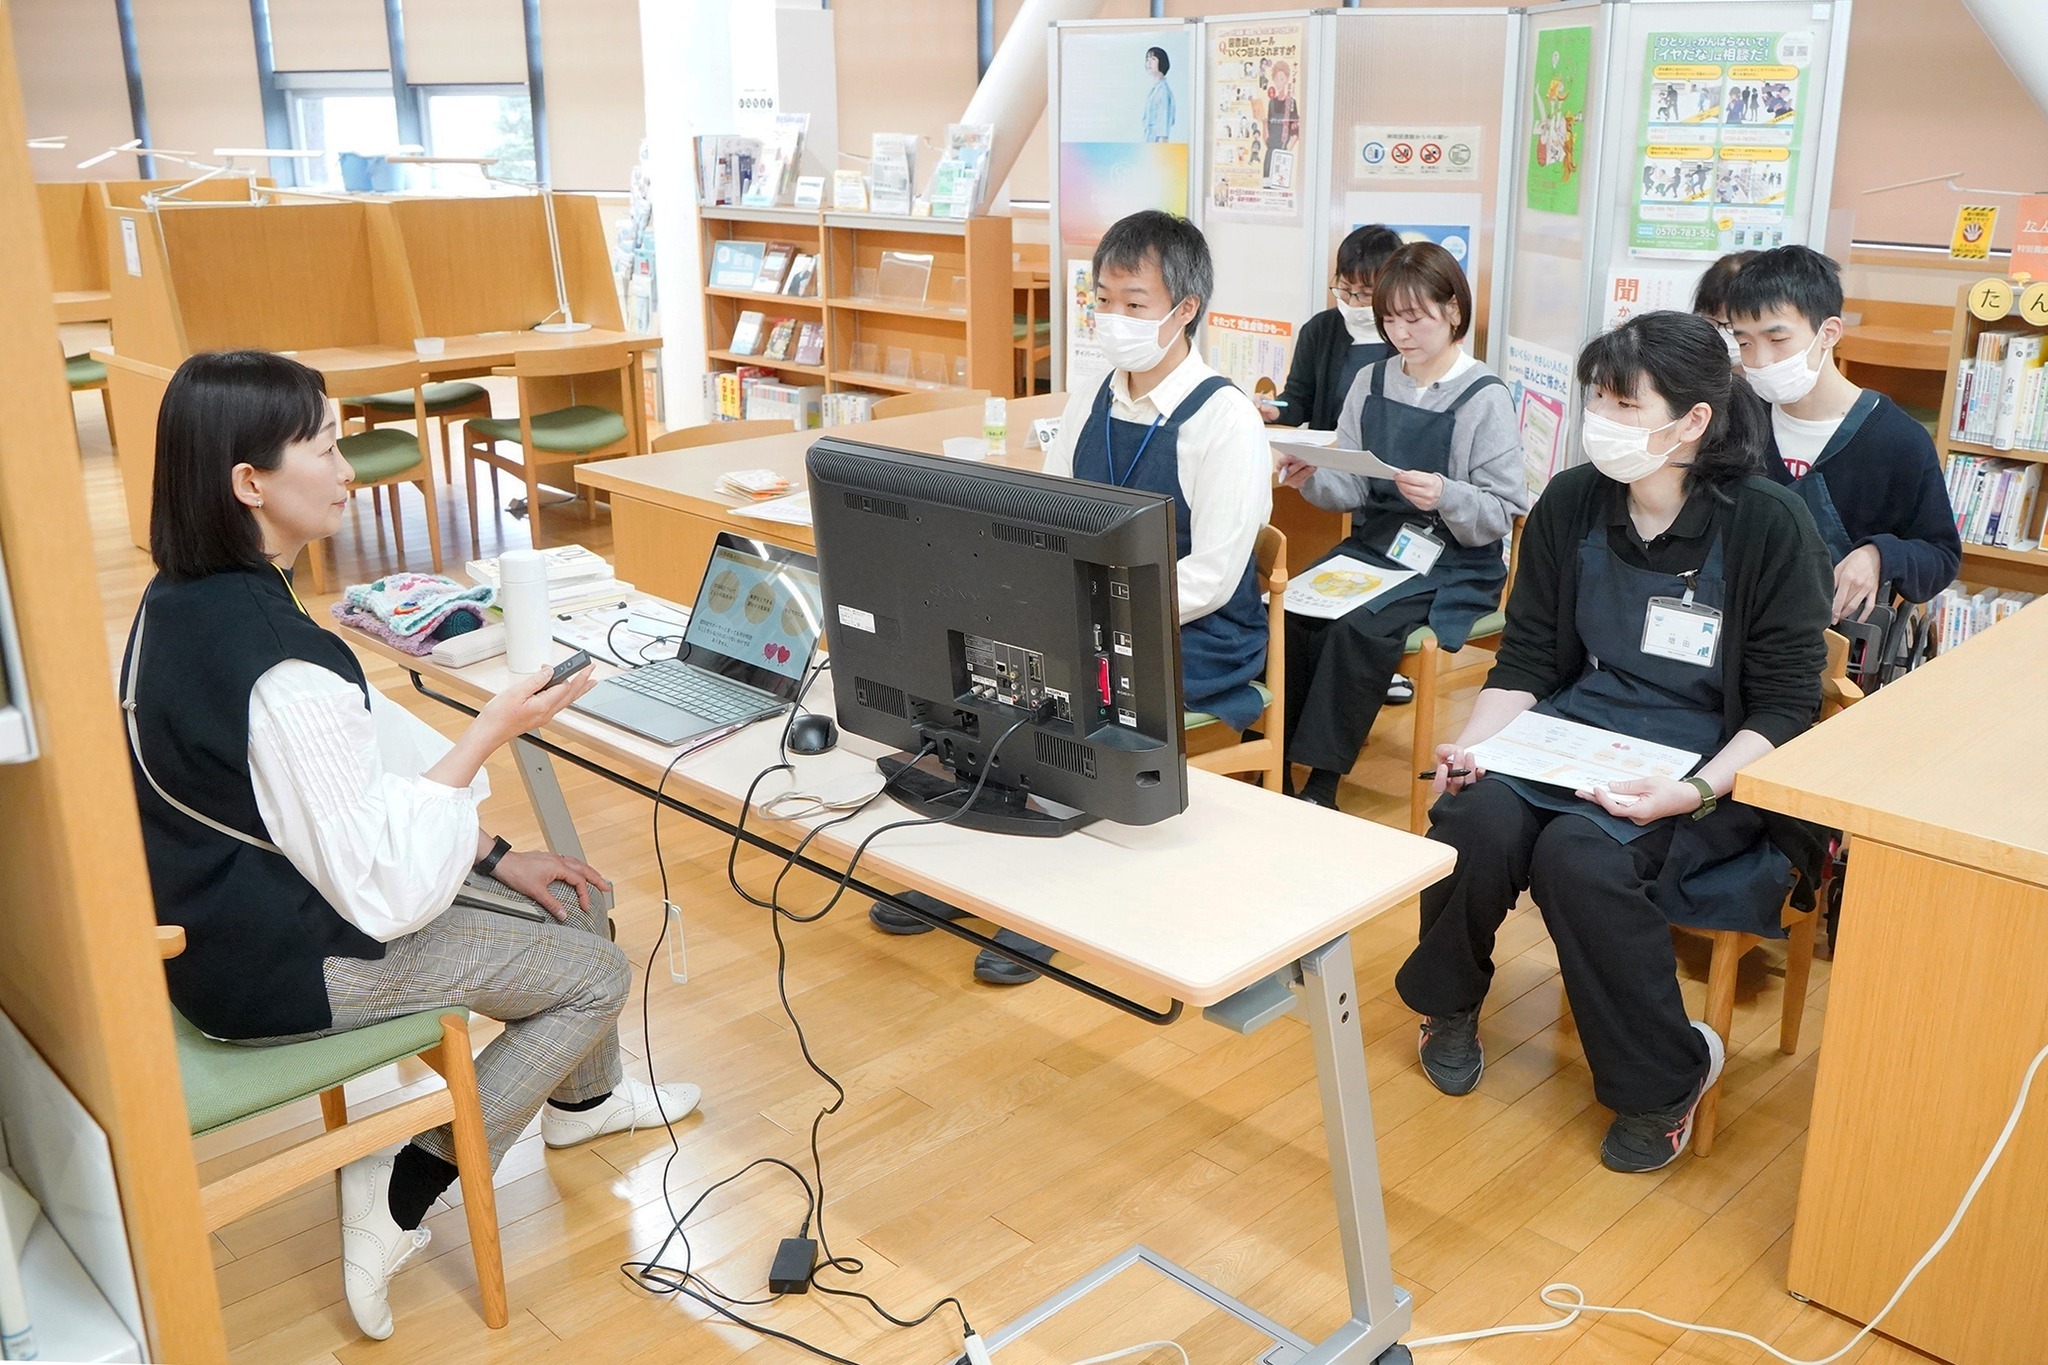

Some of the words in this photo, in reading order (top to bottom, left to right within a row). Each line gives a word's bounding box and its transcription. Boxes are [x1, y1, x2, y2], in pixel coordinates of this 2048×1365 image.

[1981, 289, 2000, 308] た
[1075, 349, 1107, 359] ダイバーシ
